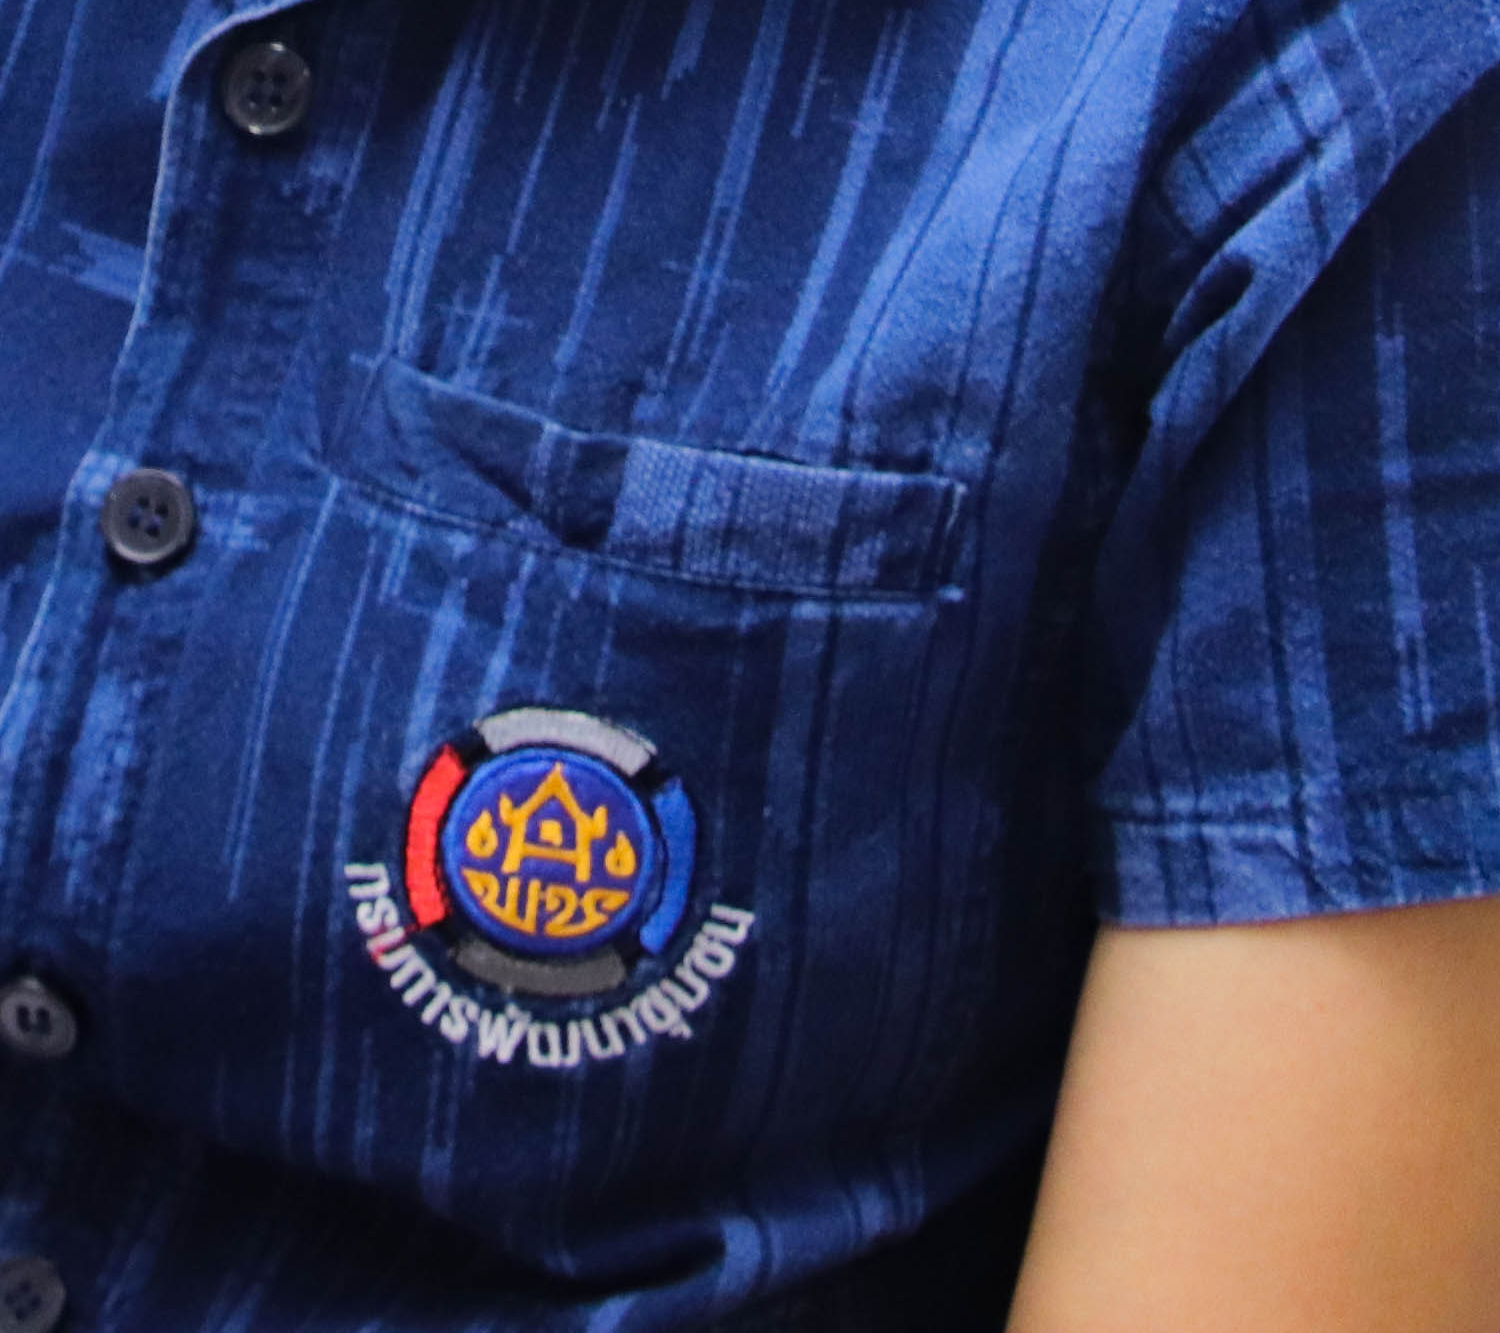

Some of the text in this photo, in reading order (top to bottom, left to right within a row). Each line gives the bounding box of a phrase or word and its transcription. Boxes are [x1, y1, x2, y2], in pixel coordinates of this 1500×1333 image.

[344, 863, 756, 1067] กรมการพัฒนาชุมชน
